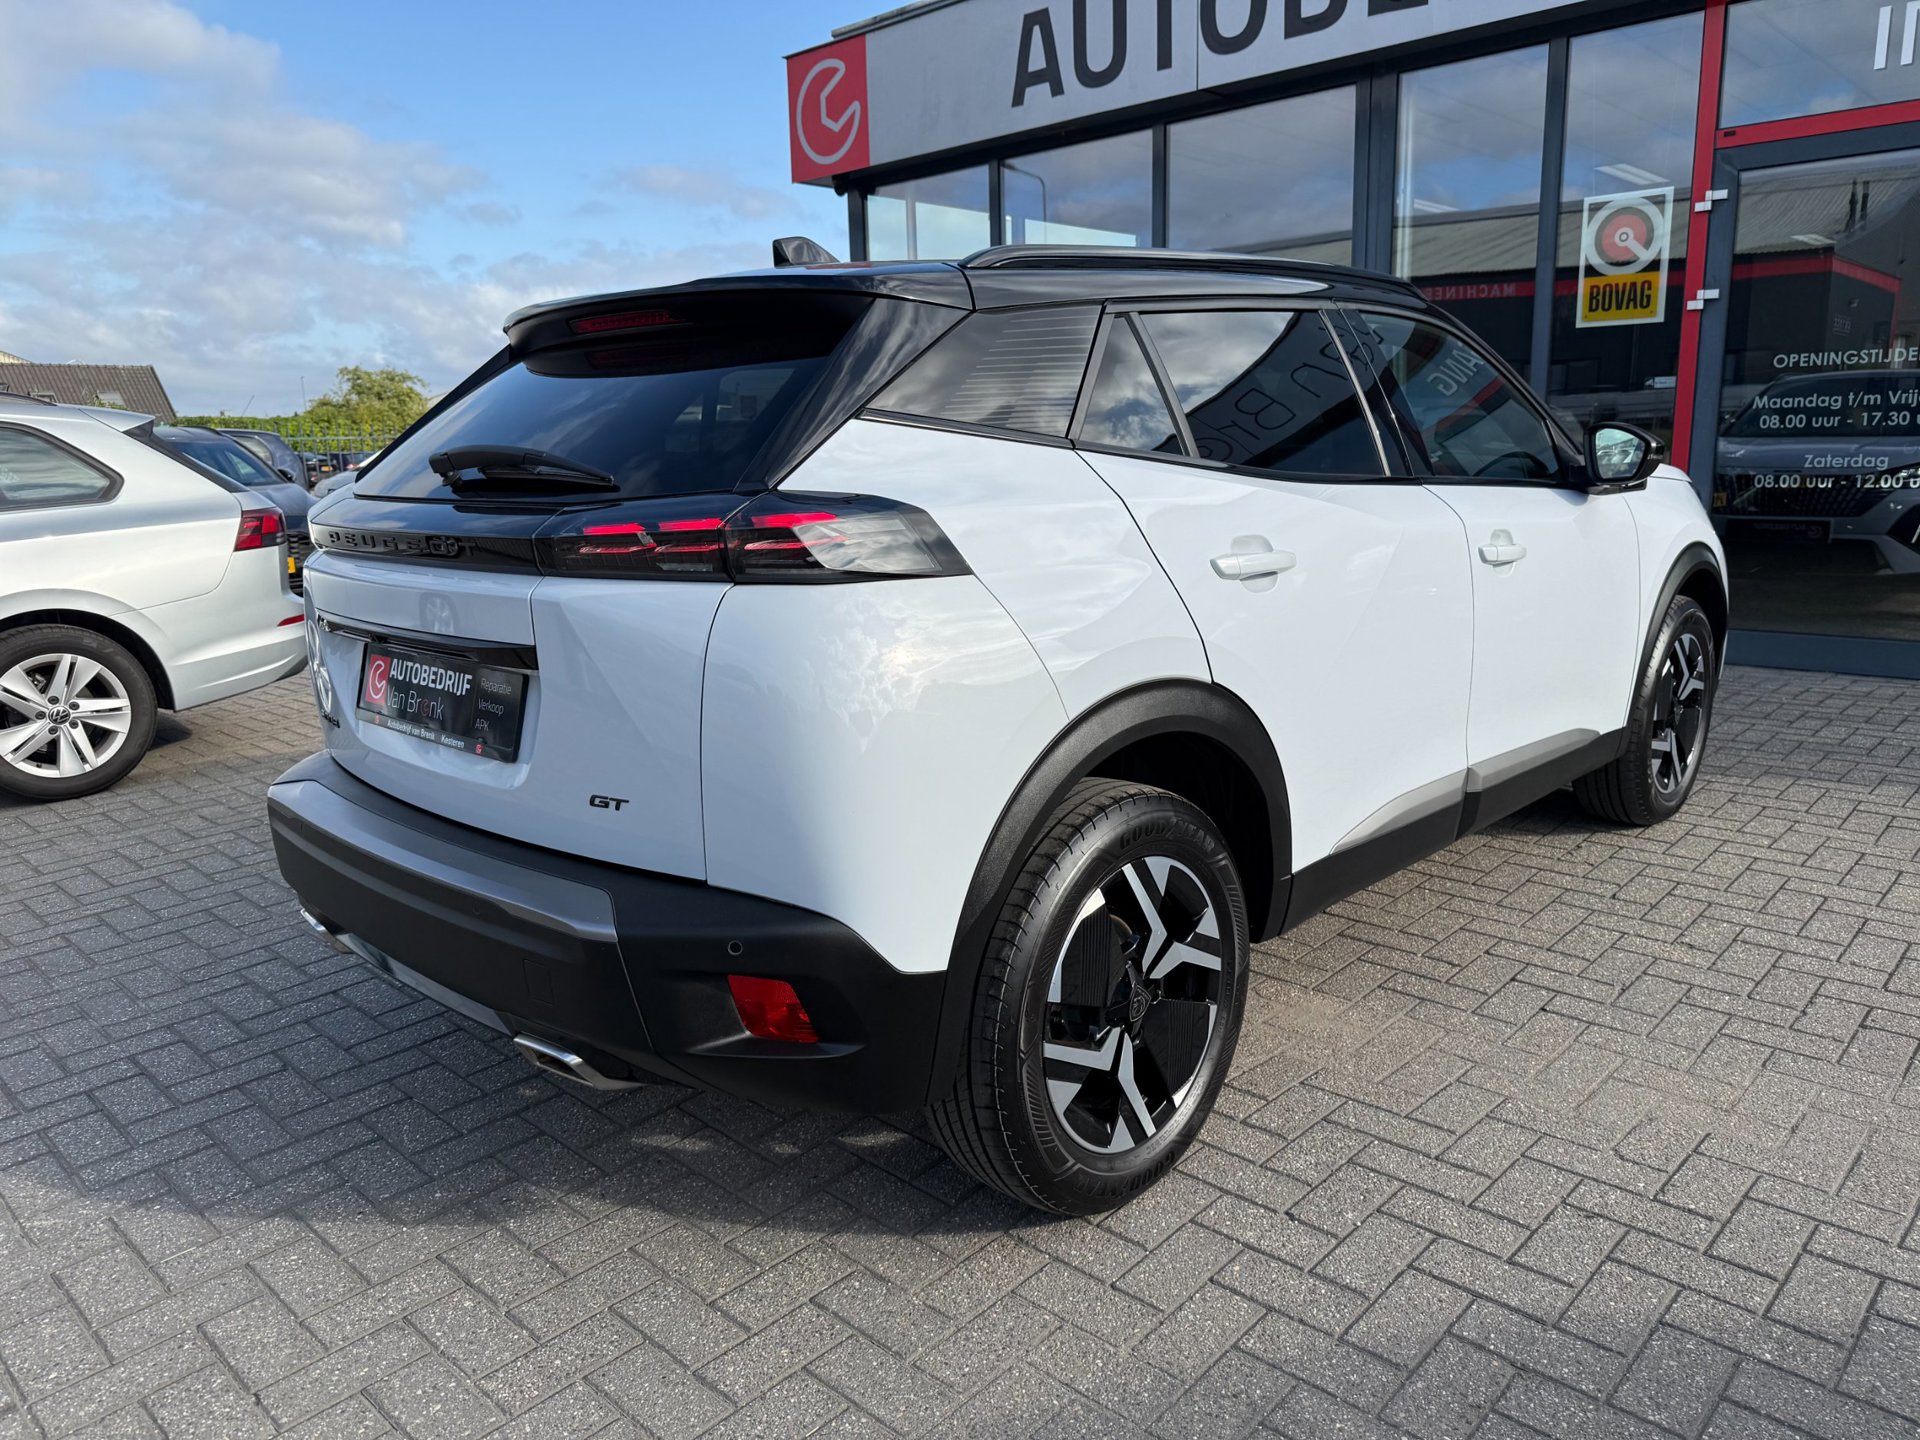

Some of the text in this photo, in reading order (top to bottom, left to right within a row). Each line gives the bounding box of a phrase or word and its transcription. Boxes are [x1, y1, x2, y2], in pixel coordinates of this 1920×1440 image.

[1011, 0, 1429, 107] AUTO
[1588, 279, 1653, 312] BOVAG
[1773, 347, 1920, 368] OPENINGSTIJDE
[1752, 388, 1920, 410] Maandag t/m Vrij
[1759, 414, 1807, 429] 08.00
[1811, 415, 1841, 428] uur
[1861, 411, 1910, 427] 17.30
[1803, 453, 1889, 471] Zaterdag
[1754, 474, 1801, 488] 08.00
[1806, 476, 1835, 489] uur
[1855, 474, 1904, 489] 12.00
[389, 658, 473, 696] AUTOBEDRIJF
[480, 677, 512, 695] Reparatie
[387, 685, 445, 721] Van Brenk
[478, 697, 504, 717] Verkoop
[474, 718, 490, 732] APK
[441, 734, 465, 748] Kesteren
[589, 794, 630, 811] GT
